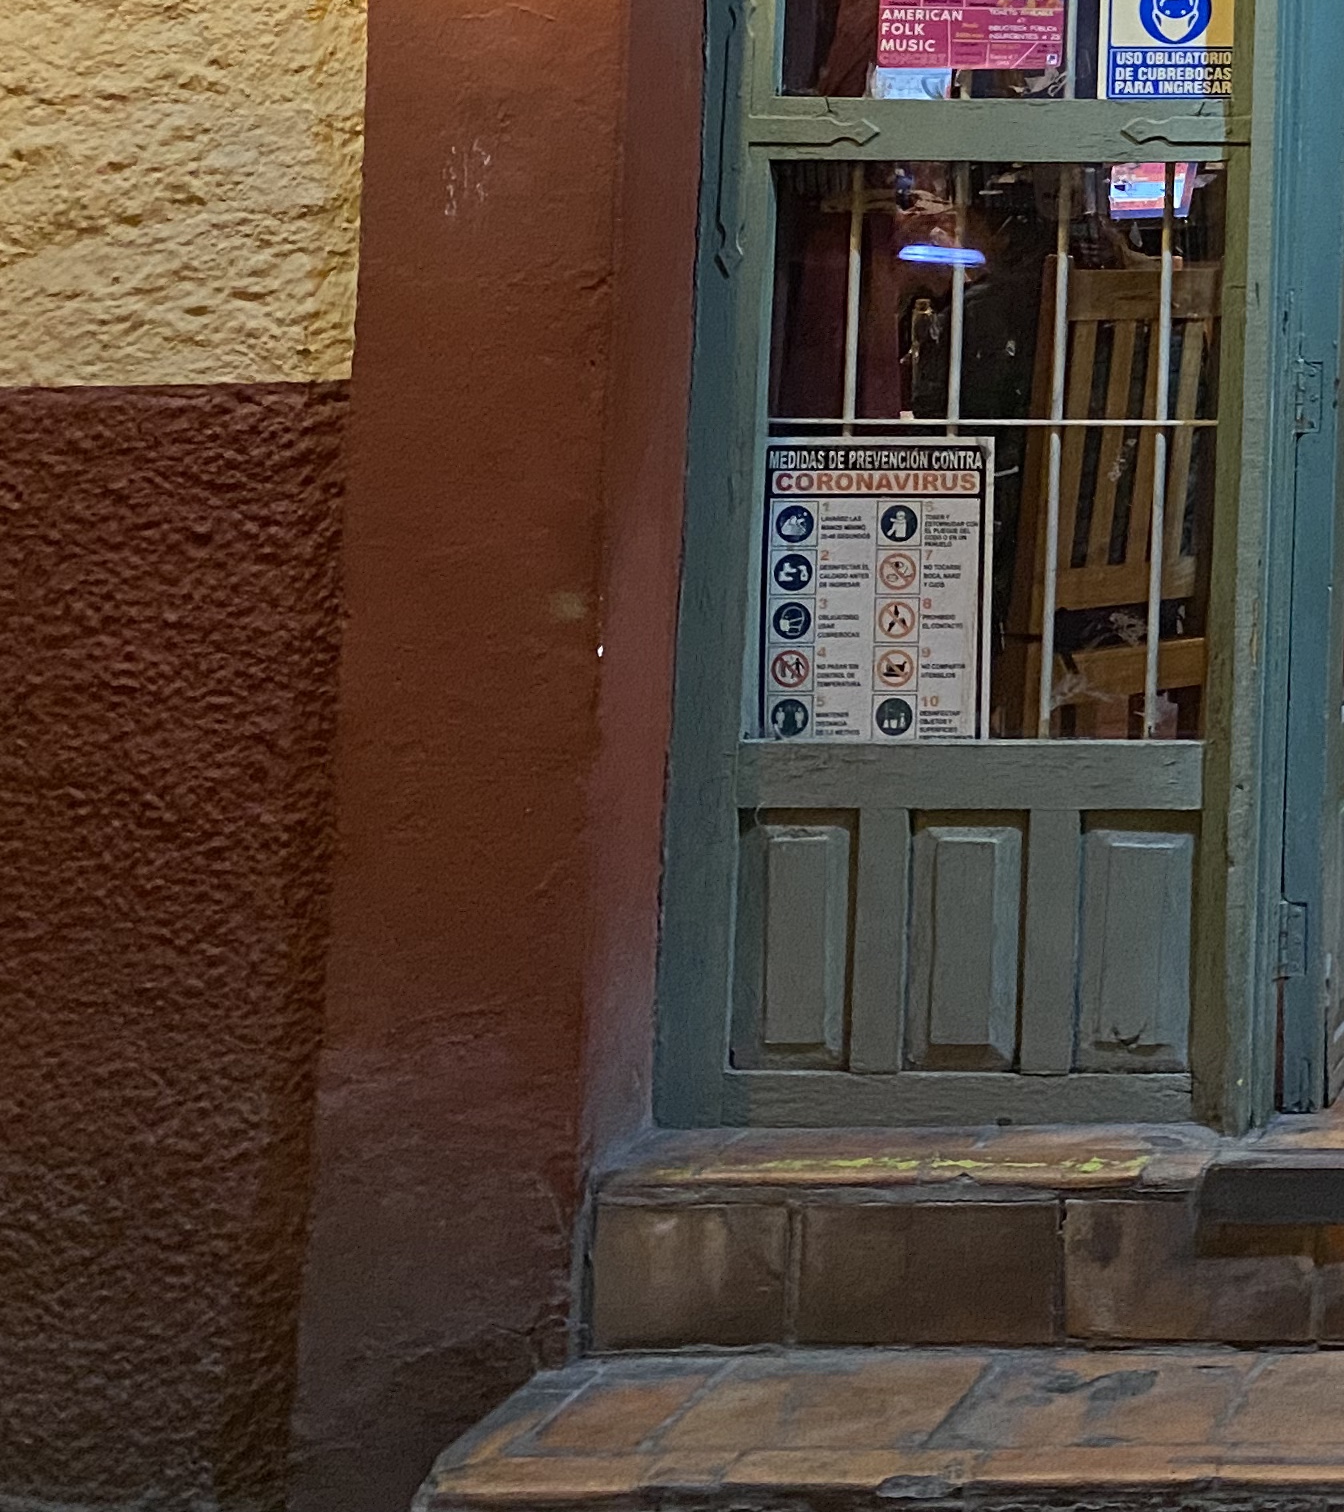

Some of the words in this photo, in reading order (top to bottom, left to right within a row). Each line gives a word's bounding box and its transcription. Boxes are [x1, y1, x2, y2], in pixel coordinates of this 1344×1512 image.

[881, 10, 963, 21] AMERICAN
[882, 23, 925, 35] FOLK
[880, 39, 936, 51] MUSIC
[1116, 52, 1143, 65] USO
[1146, 52, 1231, 65] OBLIGATORIO
[1115, 67, 1134, 80] DE
[1137, 67, 1232, 80] CUBREBOCAS
[1114, 81, 1155, 94] PARA
[1158, 81, 1232, 95] INGRESAR
[769, 451, 825, 469] MEDIDAS
[828, 451, 845, 468] DE
[850, 448, 928, 469] PREVENCIÓN
[932, 451, 983, 469] CONTRA
[776, 473, 977, 491] CORONAVIRUS
[820, 550, 830, 561] 2
[925, 550, 933, 561] 7
[819, 598, 828, 610] 3
[923, 598, 932, 609] 8
[816, 647, 827, 657] 4
[921, 695, 940, 707] 10
